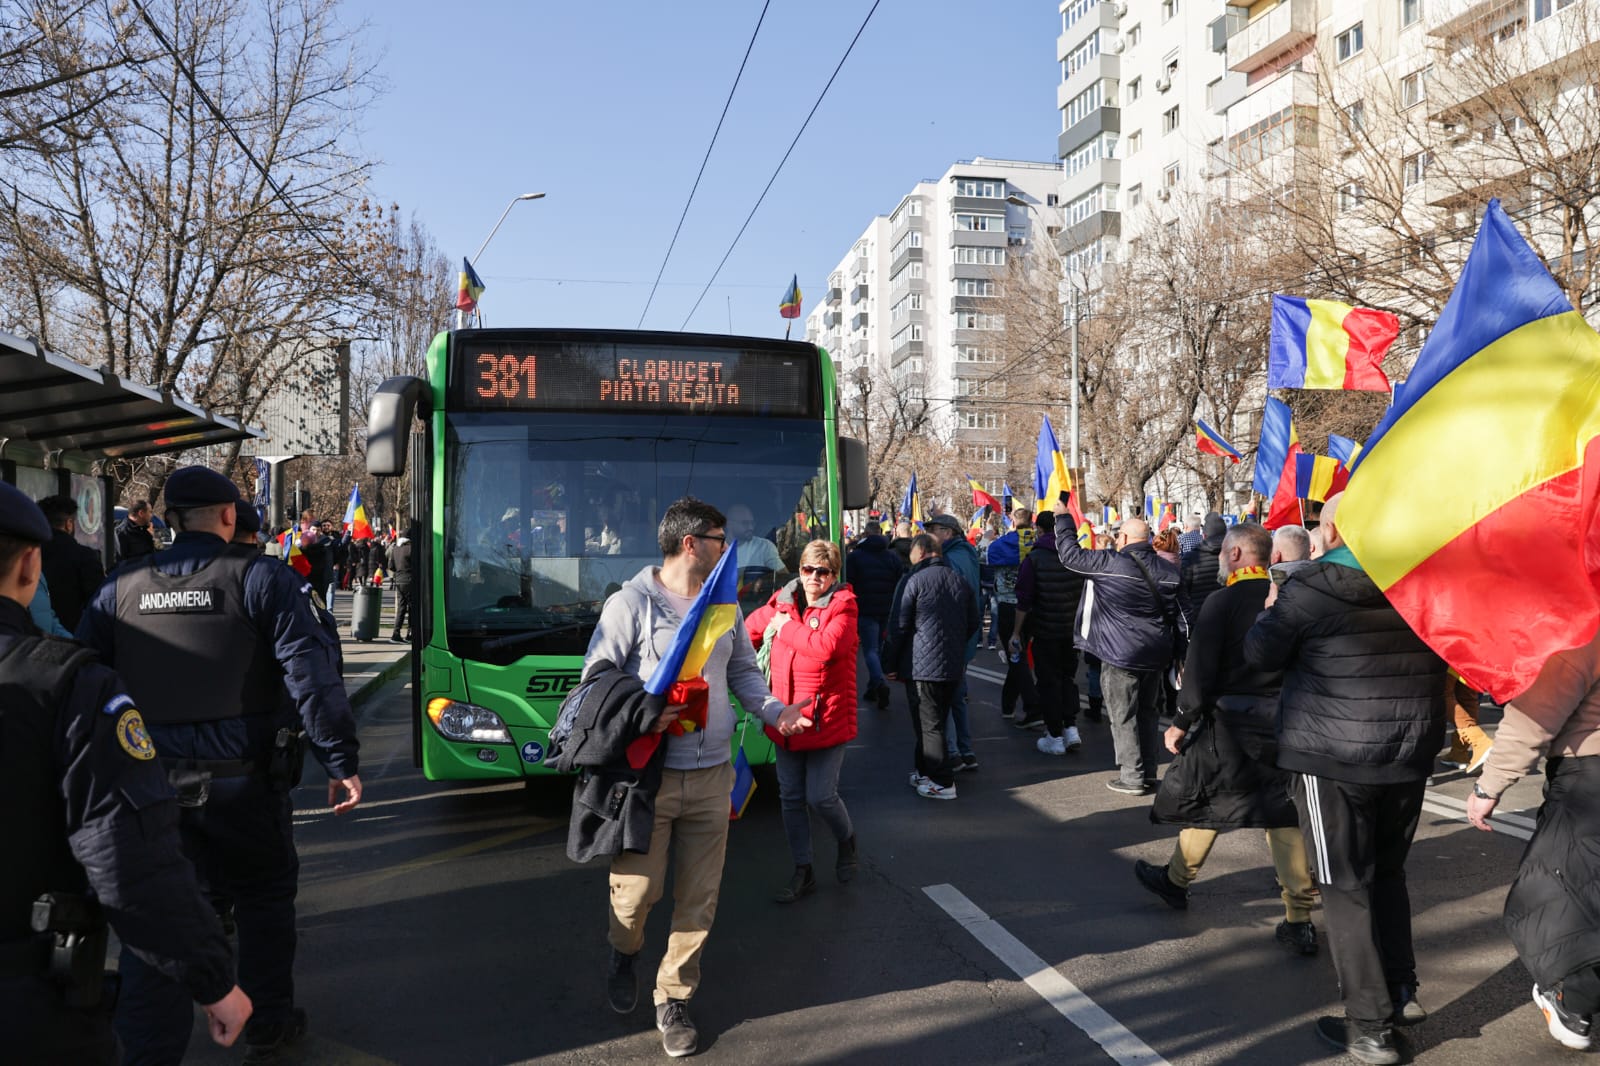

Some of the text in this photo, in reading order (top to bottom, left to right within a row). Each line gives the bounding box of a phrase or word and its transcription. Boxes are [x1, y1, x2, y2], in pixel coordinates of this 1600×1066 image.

[477, 353, 536, 399] 381
[619, 358, 723, 382] CLABUCET
[600, 379, 739, 404] PIATA RESITA
[139, 590, 212, 610] JANDARMERIA
